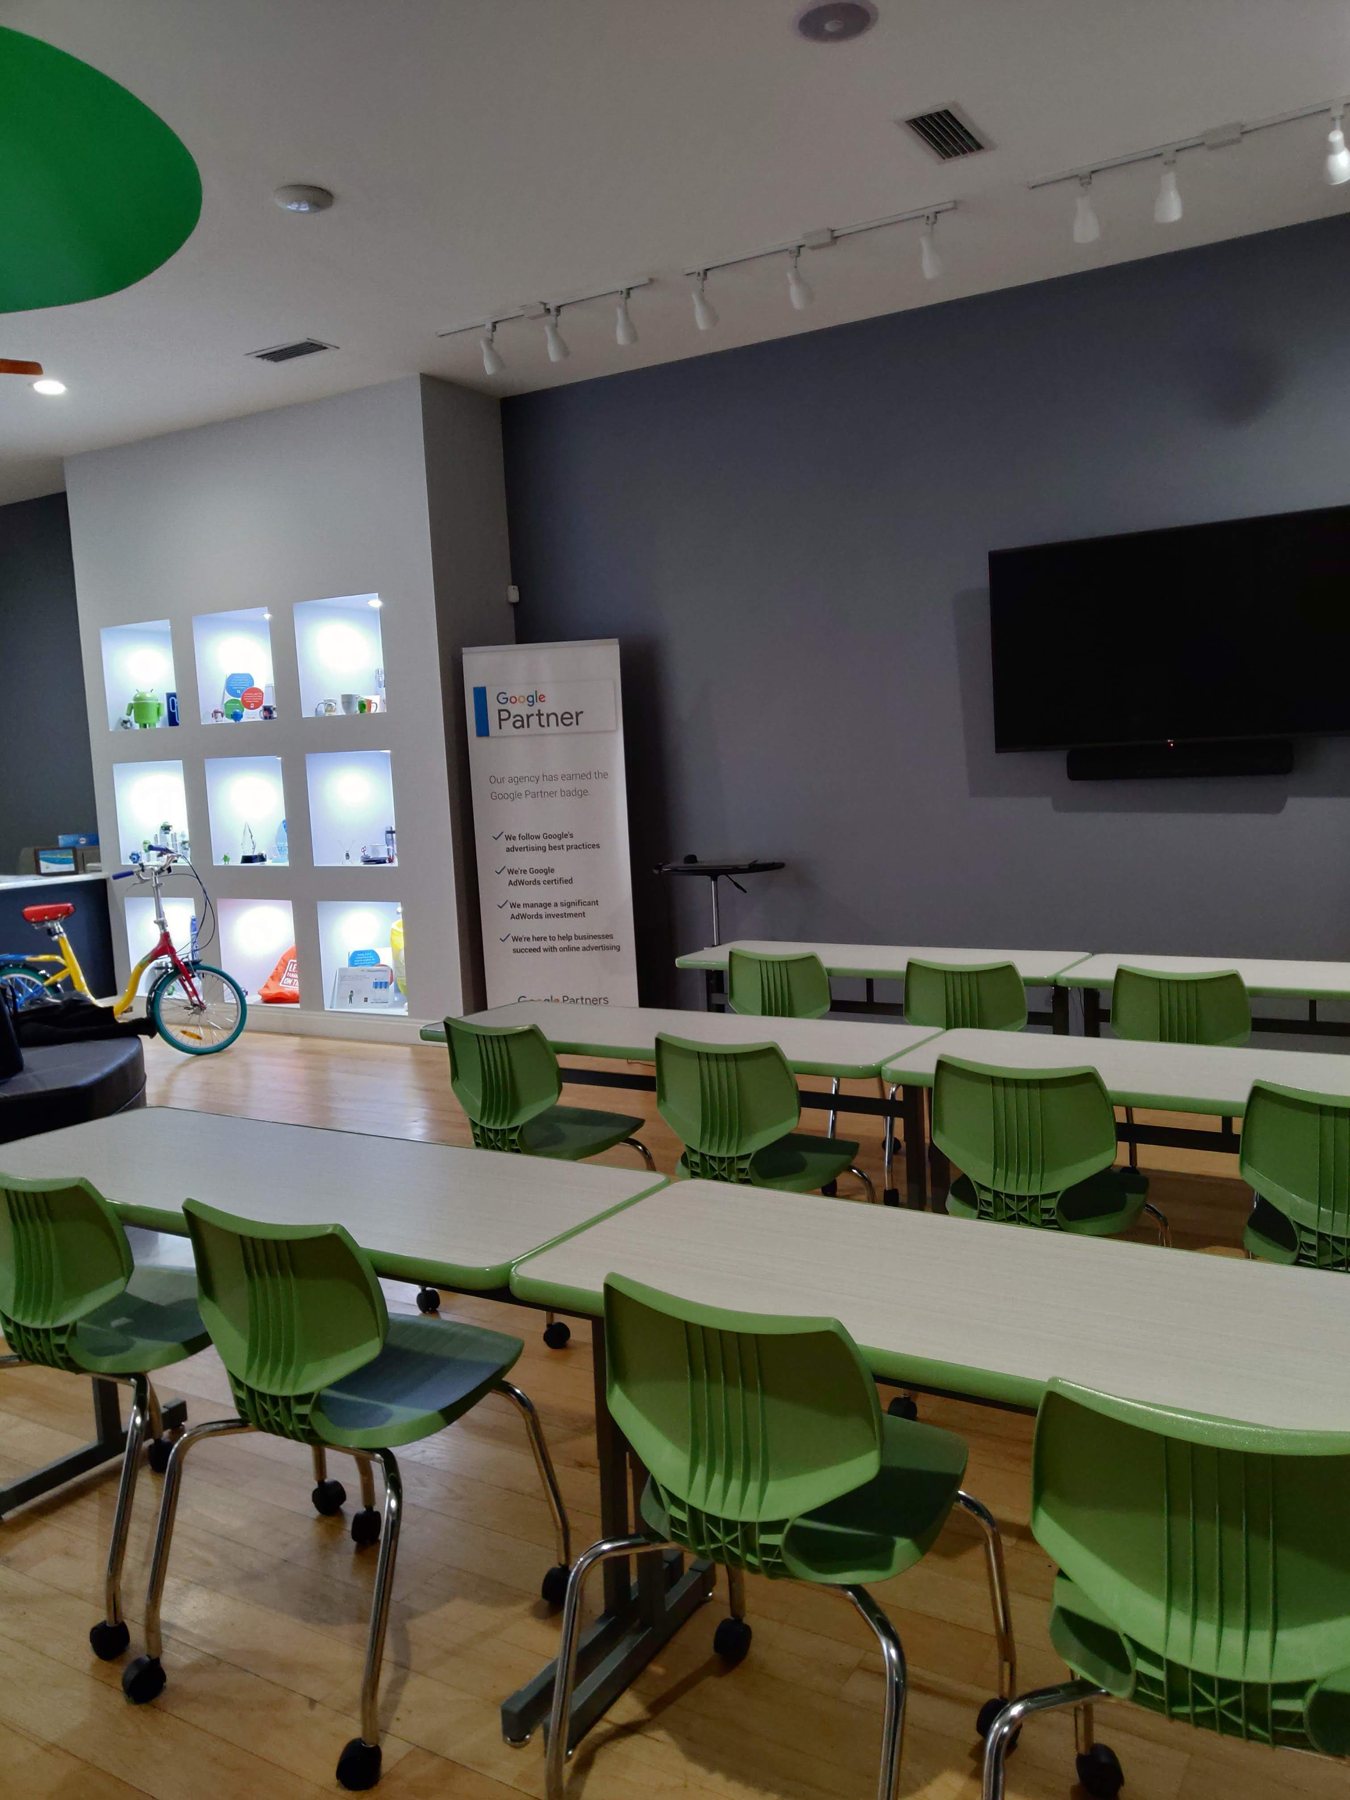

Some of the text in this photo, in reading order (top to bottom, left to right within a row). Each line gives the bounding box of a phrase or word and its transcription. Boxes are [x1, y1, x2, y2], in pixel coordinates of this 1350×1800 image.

[496, 690, 546, 706] Google
[498, 709, 584, 730] Partner
[489, 770, 608, 786] Our agency has earned the
[490, 791, 522, 802] Google
[525, 790, 557, 798] Partner
[543, 832, 574, 841] Google's
[506, 845, 546, 853] advertising
[566, 843, 600, 851] practices
[529, 867, 554, 876] Google
[522, 902, 552, 910] manage
[560, 899, 599, 908] significant
[557, 934, 572, 942] help
[582, 944, 620, 952] advertising
[562, 995, 609, 1005] Partners
